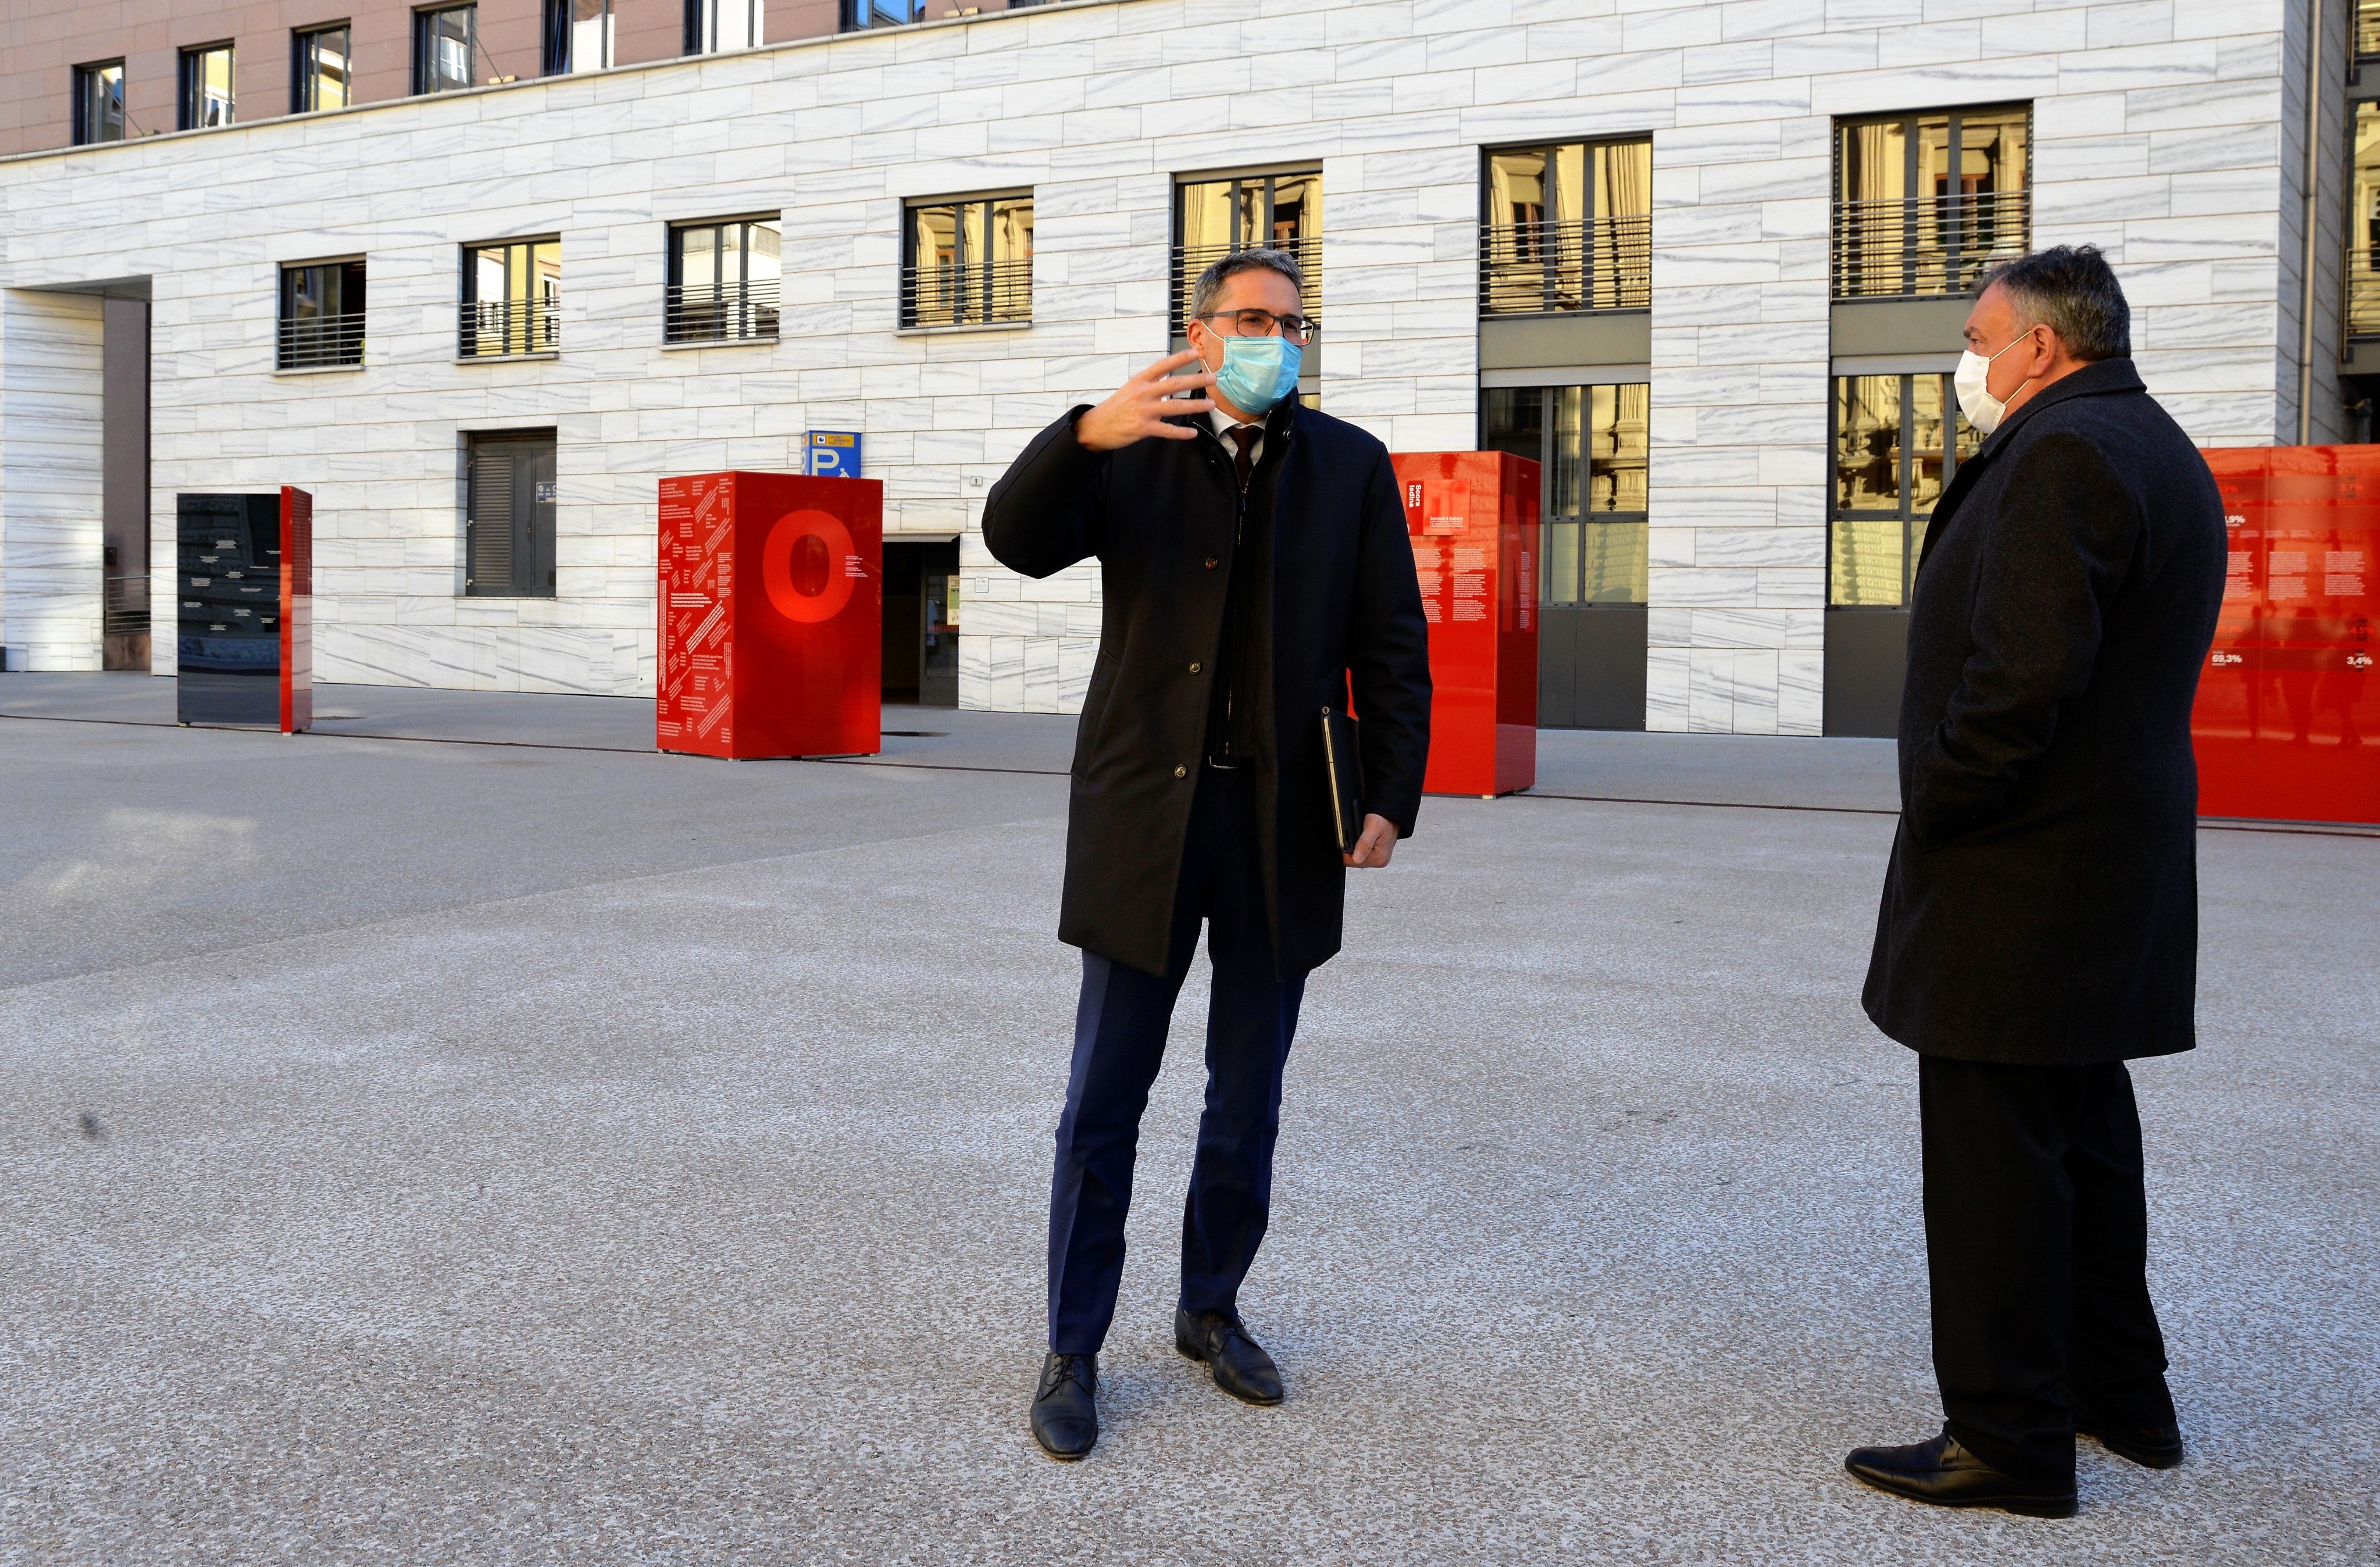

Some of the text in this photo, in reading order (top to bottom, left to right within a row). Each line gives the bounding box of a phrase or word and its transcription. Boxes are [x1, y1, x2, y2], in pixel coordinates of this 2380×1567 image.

[812, 448, 839, 476] P
[2212, 654, 2242, 663] 69,3%
[2347, 656, 2373, 665] 3,4%
